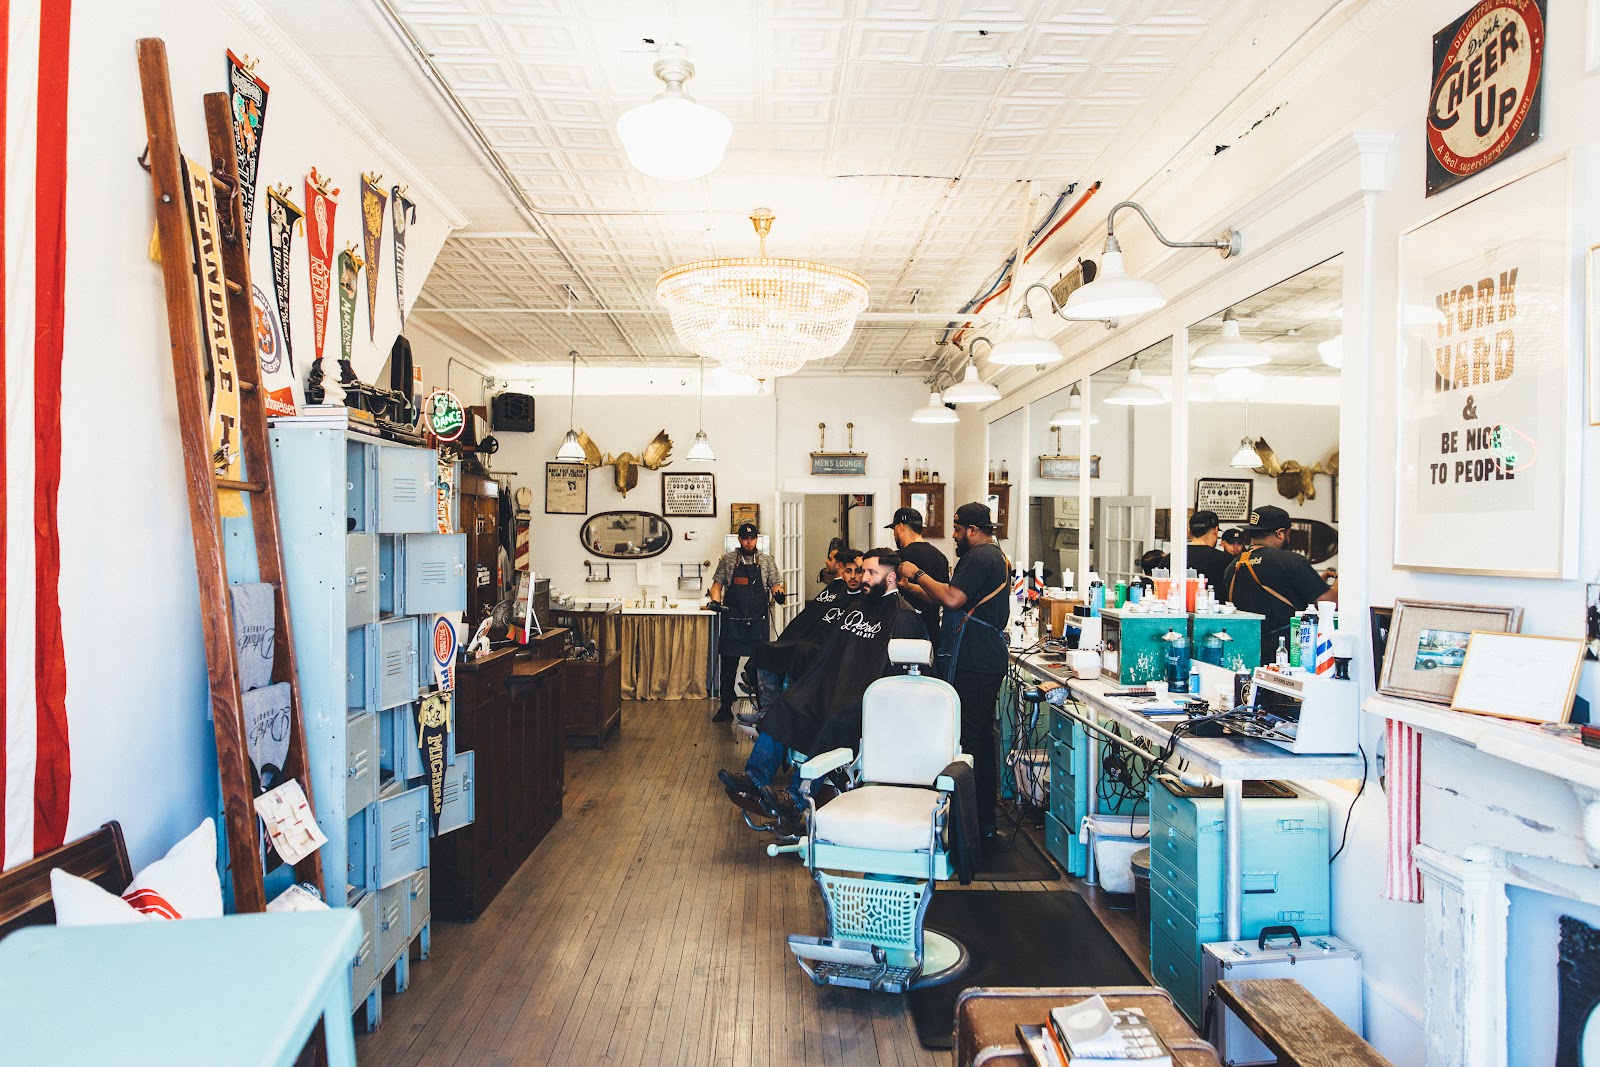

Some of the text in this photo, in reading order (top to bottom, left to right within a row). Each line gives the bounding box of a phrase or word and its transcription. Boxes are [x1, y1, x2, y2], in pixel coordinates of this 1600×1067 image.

[1447, 54, 1454, 63] A
[1454, 0, 1493, 49] DELIGHTFUL
[1465, 14, 1500, 60] Drink
[1428, 20, 1519, 131] CHEER
[1474, 83, 1517, 137] UP
[1437, 145, 1444, 155] A
[1443, 152, 1458, 169] Real
[1459, 131, 1510, 173] supercharged
[1512, 95, 1530, 131] mixer
[311, 253, 325, 302] RED
[253, 287, 271, 312] ROIT
[1436, 267, 1518, 339] WORK
[341, 297, 352, 355] MACKINAW
[261, 357, 281, 372] GERS
[1435, 329, 1514, 393] HARD
[265, 394, 296, 416] dweiser
[433, 411, 462, 429] DANCE
[451, 400, 458, 410] A
[1462, 394, 1478, 420] &
[1441, 431, 1459, 454] BE
[1466, 424, 1502, 451] NICE
[835, 459, 863, 467] LOUNGE
[1430, 457, 1515, 485] TO PEOPLE
[1273, 677, 1295, 687] STERILIZER
[427, 733, 443, 814] MICHIGAN
